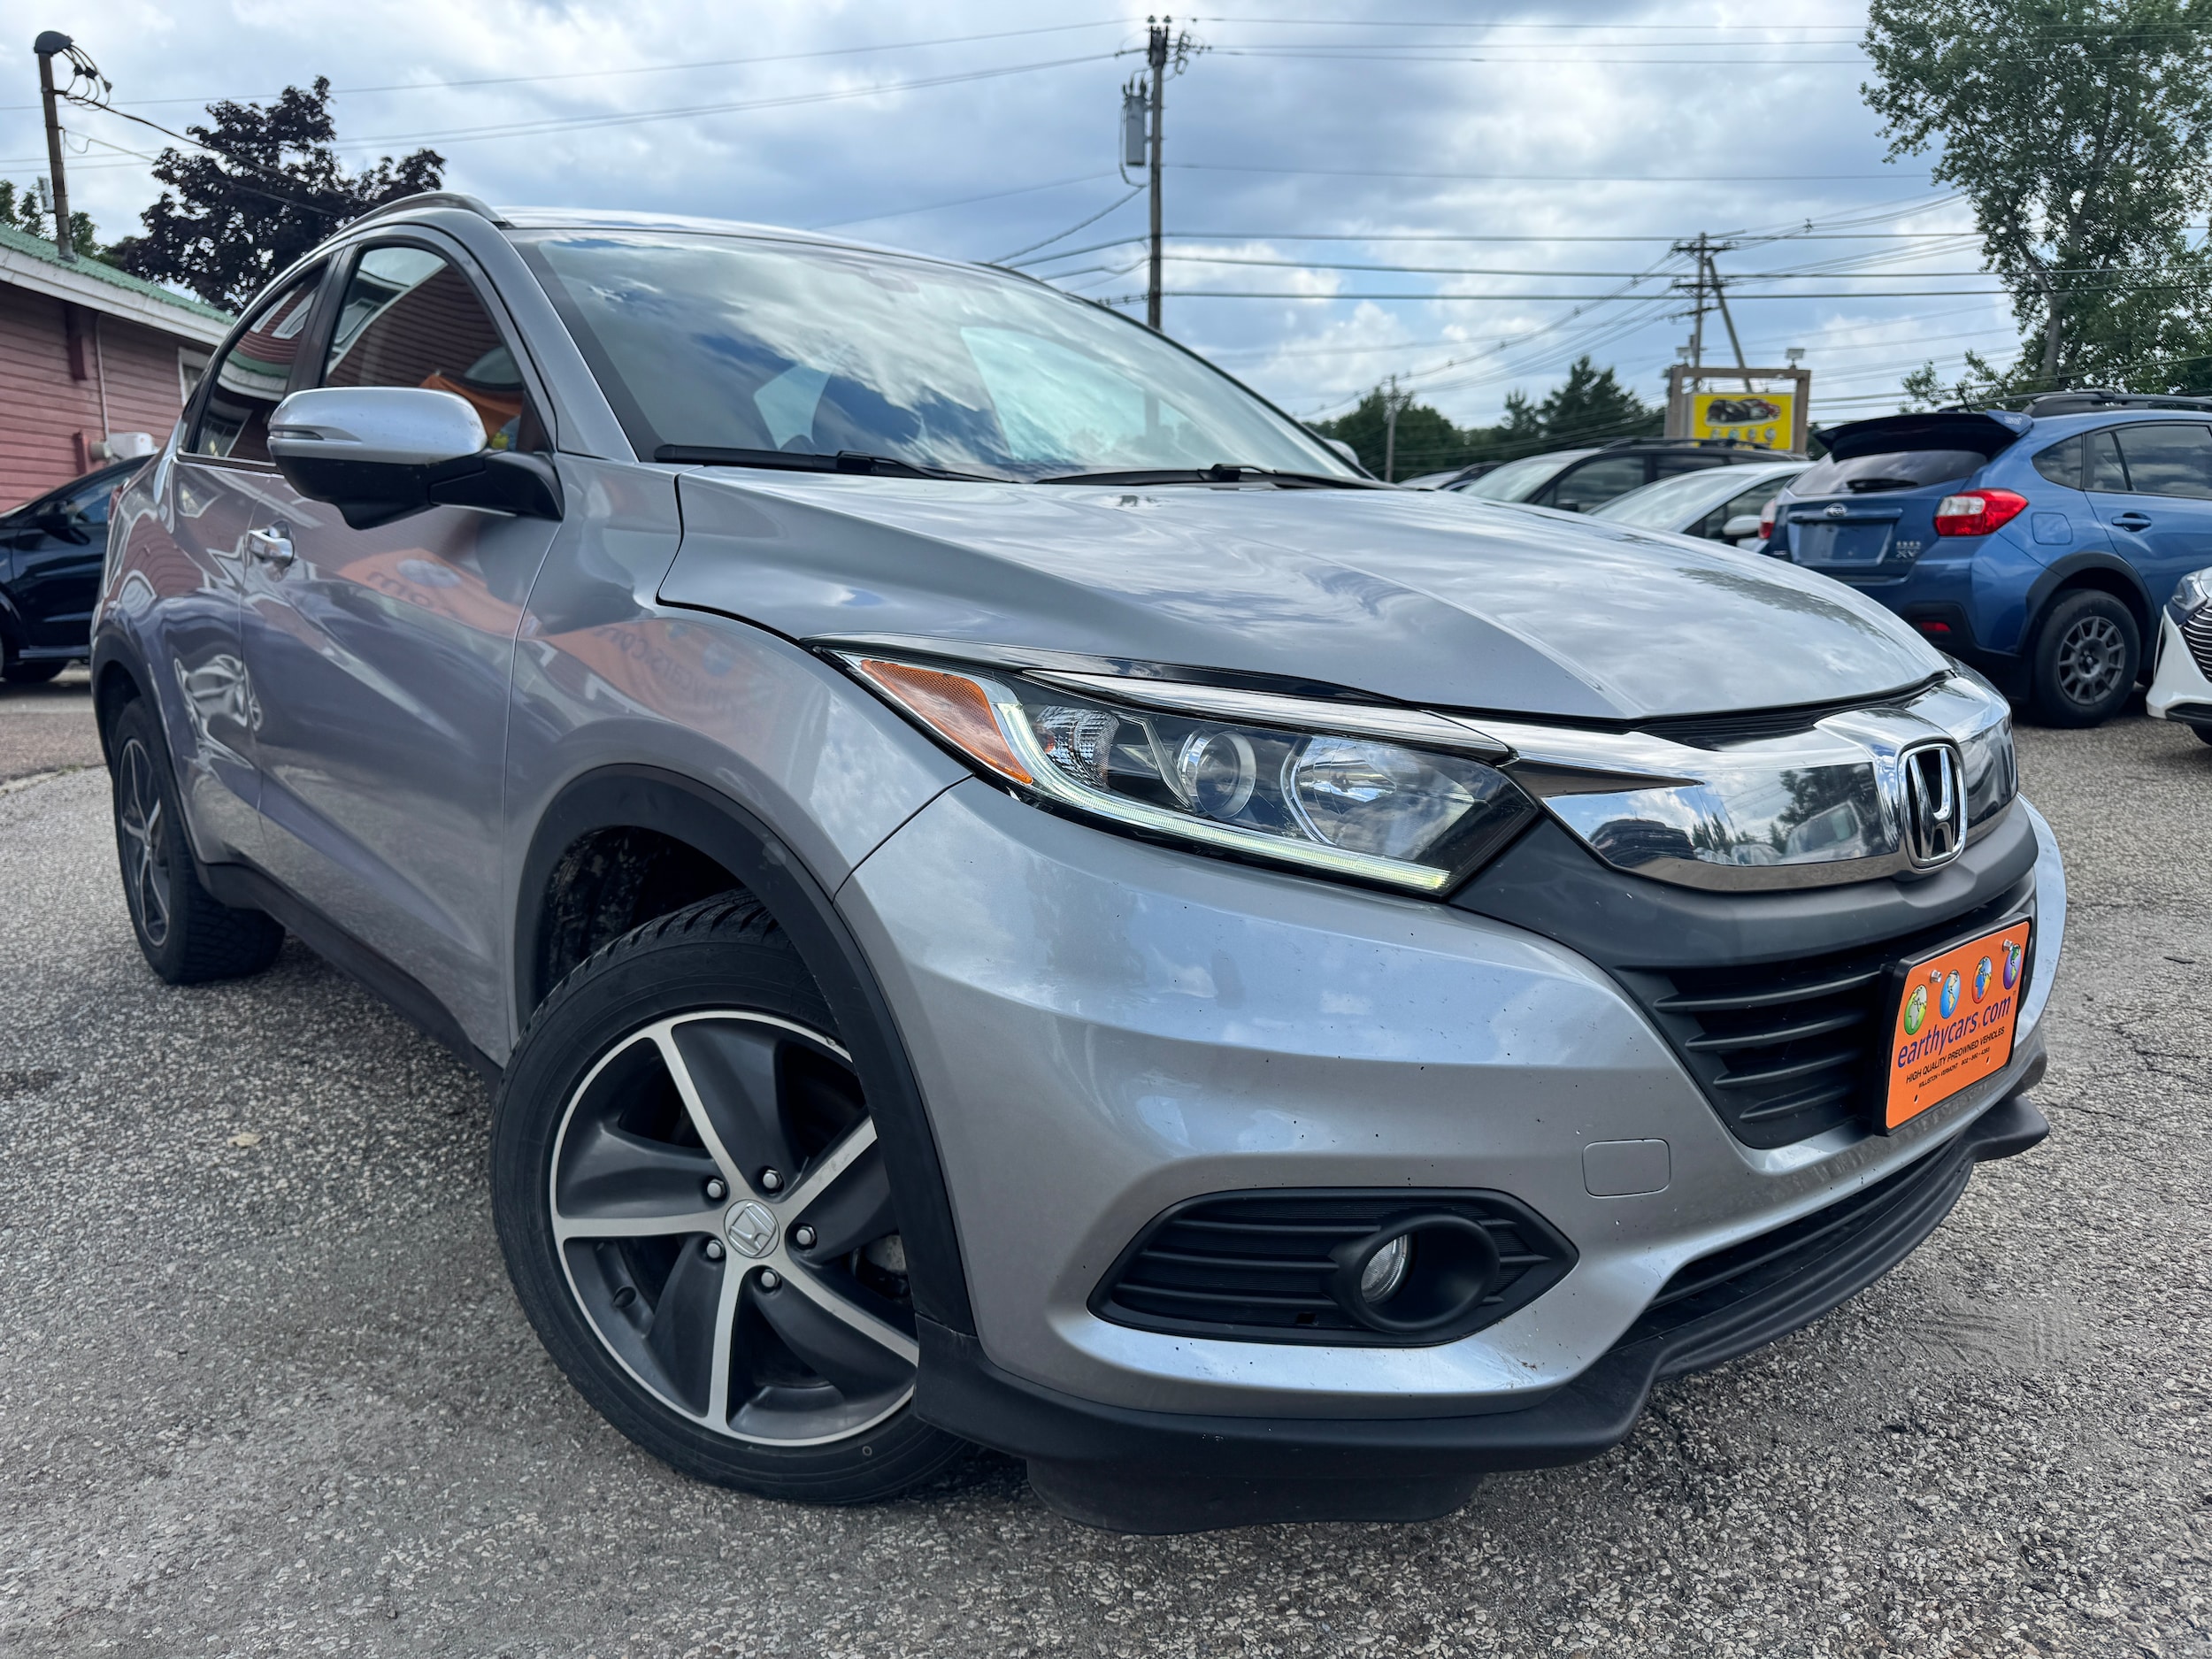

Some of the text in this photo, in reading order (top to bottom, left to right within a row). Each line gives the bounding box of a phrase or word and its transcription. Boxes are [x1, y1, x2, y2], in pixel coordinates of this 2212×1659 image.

[1898, 996, 2011, 1068] earthycars.com
[1906, 1026, 2005, 1084] HIGH QUALITY PREOWNED VEHICLES
